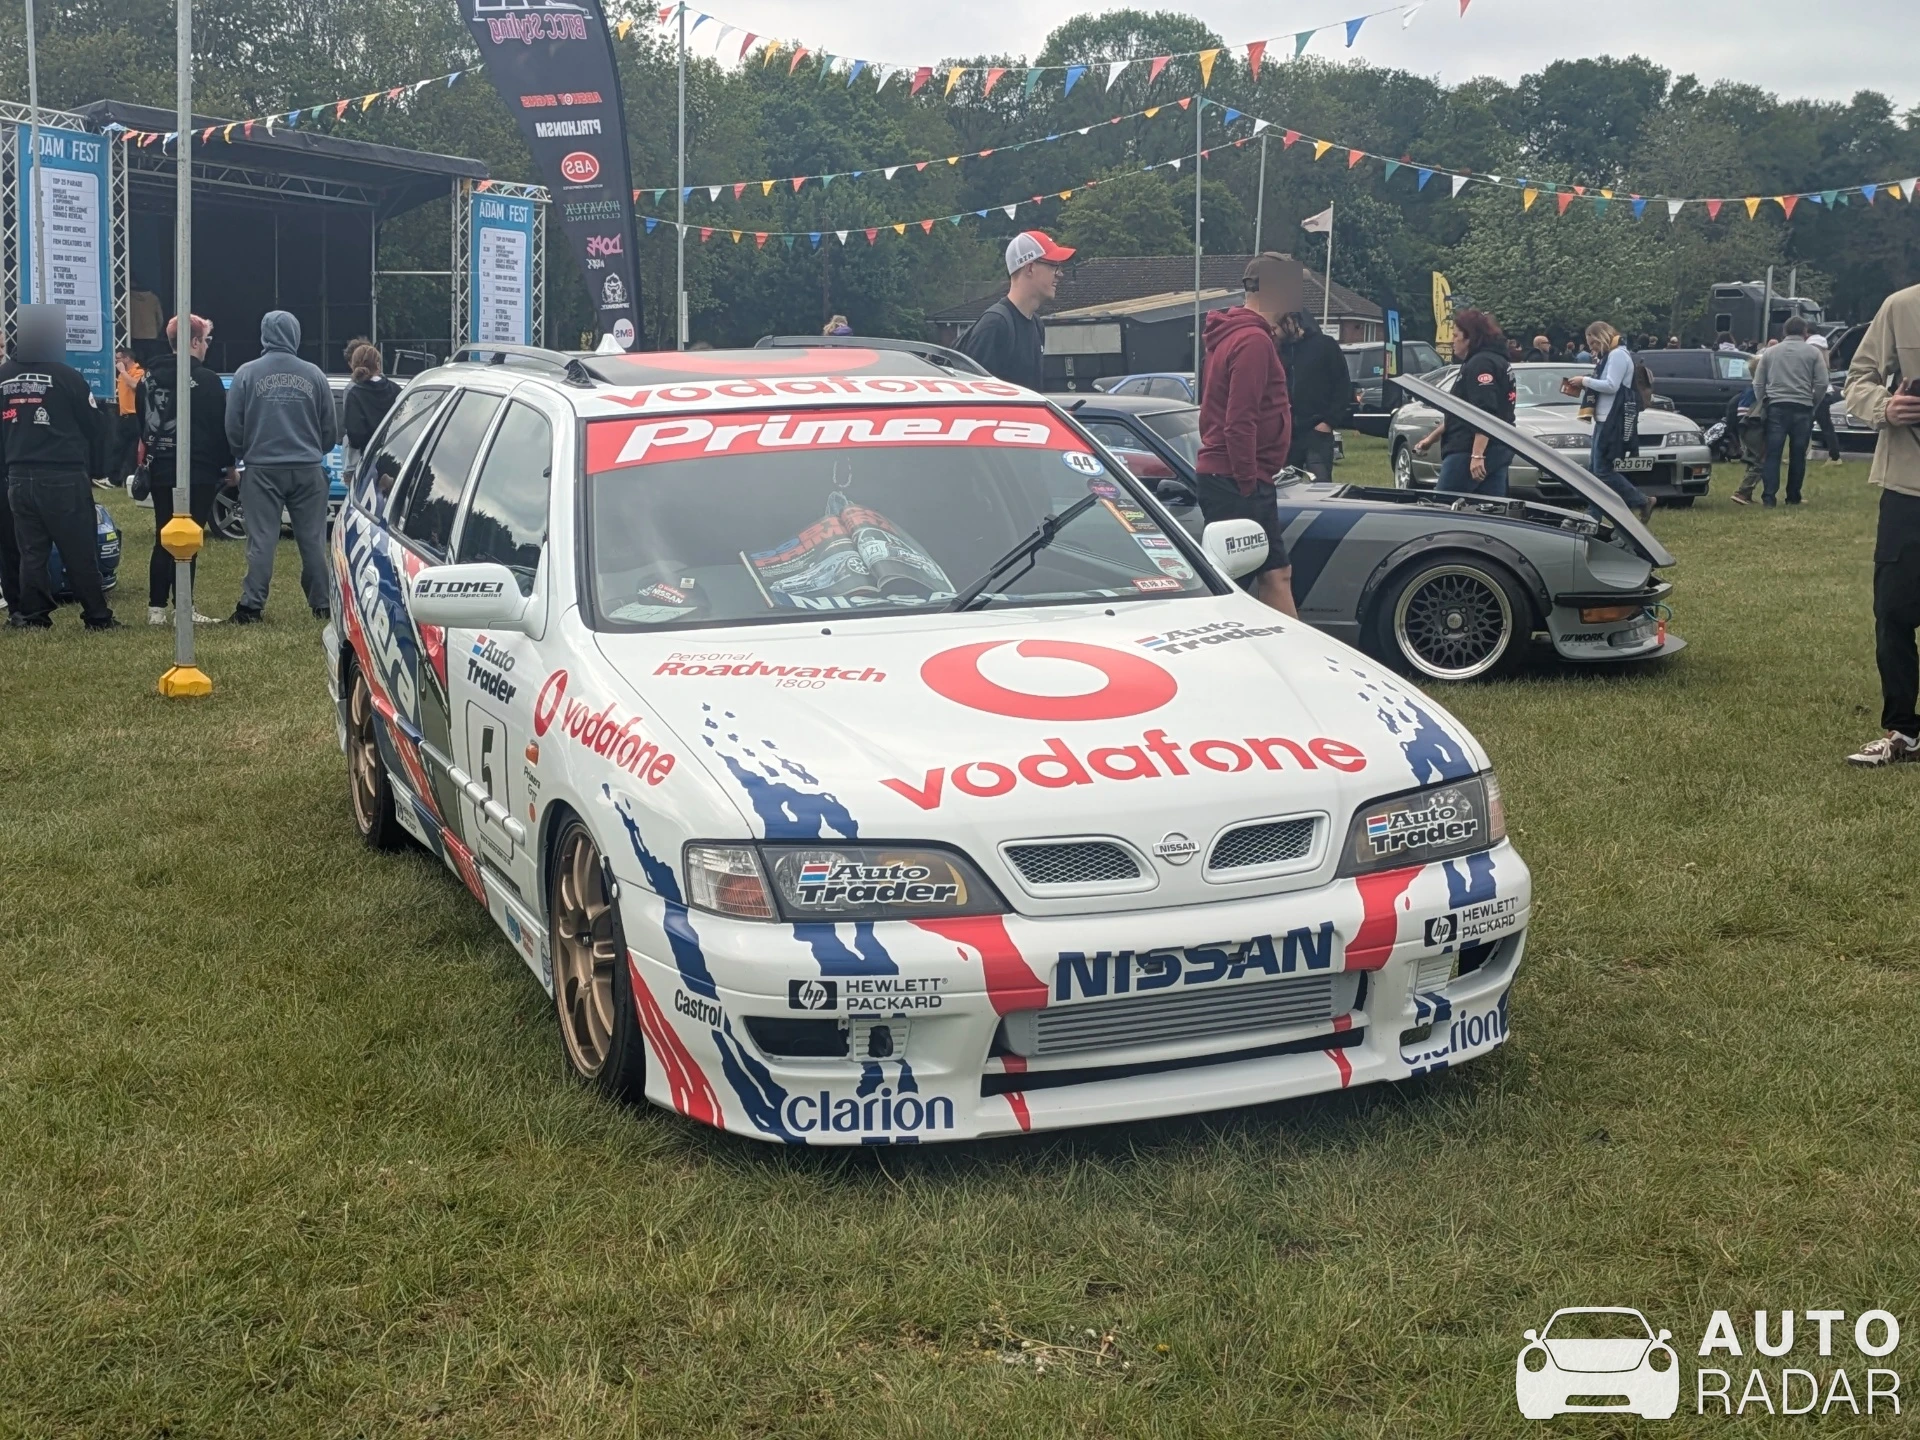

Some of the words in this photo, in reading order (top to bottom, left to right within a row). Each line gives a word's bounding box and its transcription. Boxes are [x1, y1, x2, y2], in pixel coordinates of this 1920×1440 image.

[72, 140, 101, 163] FEST
[479, 201, 504, 220] ADAM
[509, 205, 528, 223] FEST
[599, 376, 1021, 408] vodafone
[615, 414, 1052, 464] Primera
[1072, 455, 1094, 471] 44
[1615, 460, 1633, 468] R33
[1635, 460, 1652, 468] GTR
[431, 581, 504, 593] TOMEI
[652, 588, 684, 604] NISSAN
[1153, 624, 1285, 656] Trader
[1162, 619, 1245, 642] Auto
[1574, 632, 1605, 642] WORK
[480, 640, 516, 674] Auto
[666, 651, 754, 666] Personal
[468, 660, 516, 704] Trader
[653, 660, 888, 684] Roadwatch
[774, 678, 826, 690] 1800
[561, 697, 676, 786] vodafone
[524, 766, 540, 789] Primera
[878, 728, 1367, 812] vodafone
[1390, 806, 1458, 828] Auto
[1158, 843, 1197, 852] NISSAN
[1370, 820, 1479, 853] Trader
[826, 862, 930, 882] Auto
[800, 882, 957, 904] Trader
[1434, 918, 1450, 944] hp
[1462, 914, 1516, 939] PACKARD
[1055, 921, 1336, 1002] NISSAN
[800, 982, 824, 1008] hp
[847, 995, 942, 1010] PACKARD
[675, 989, 722, 1028] Castrol
